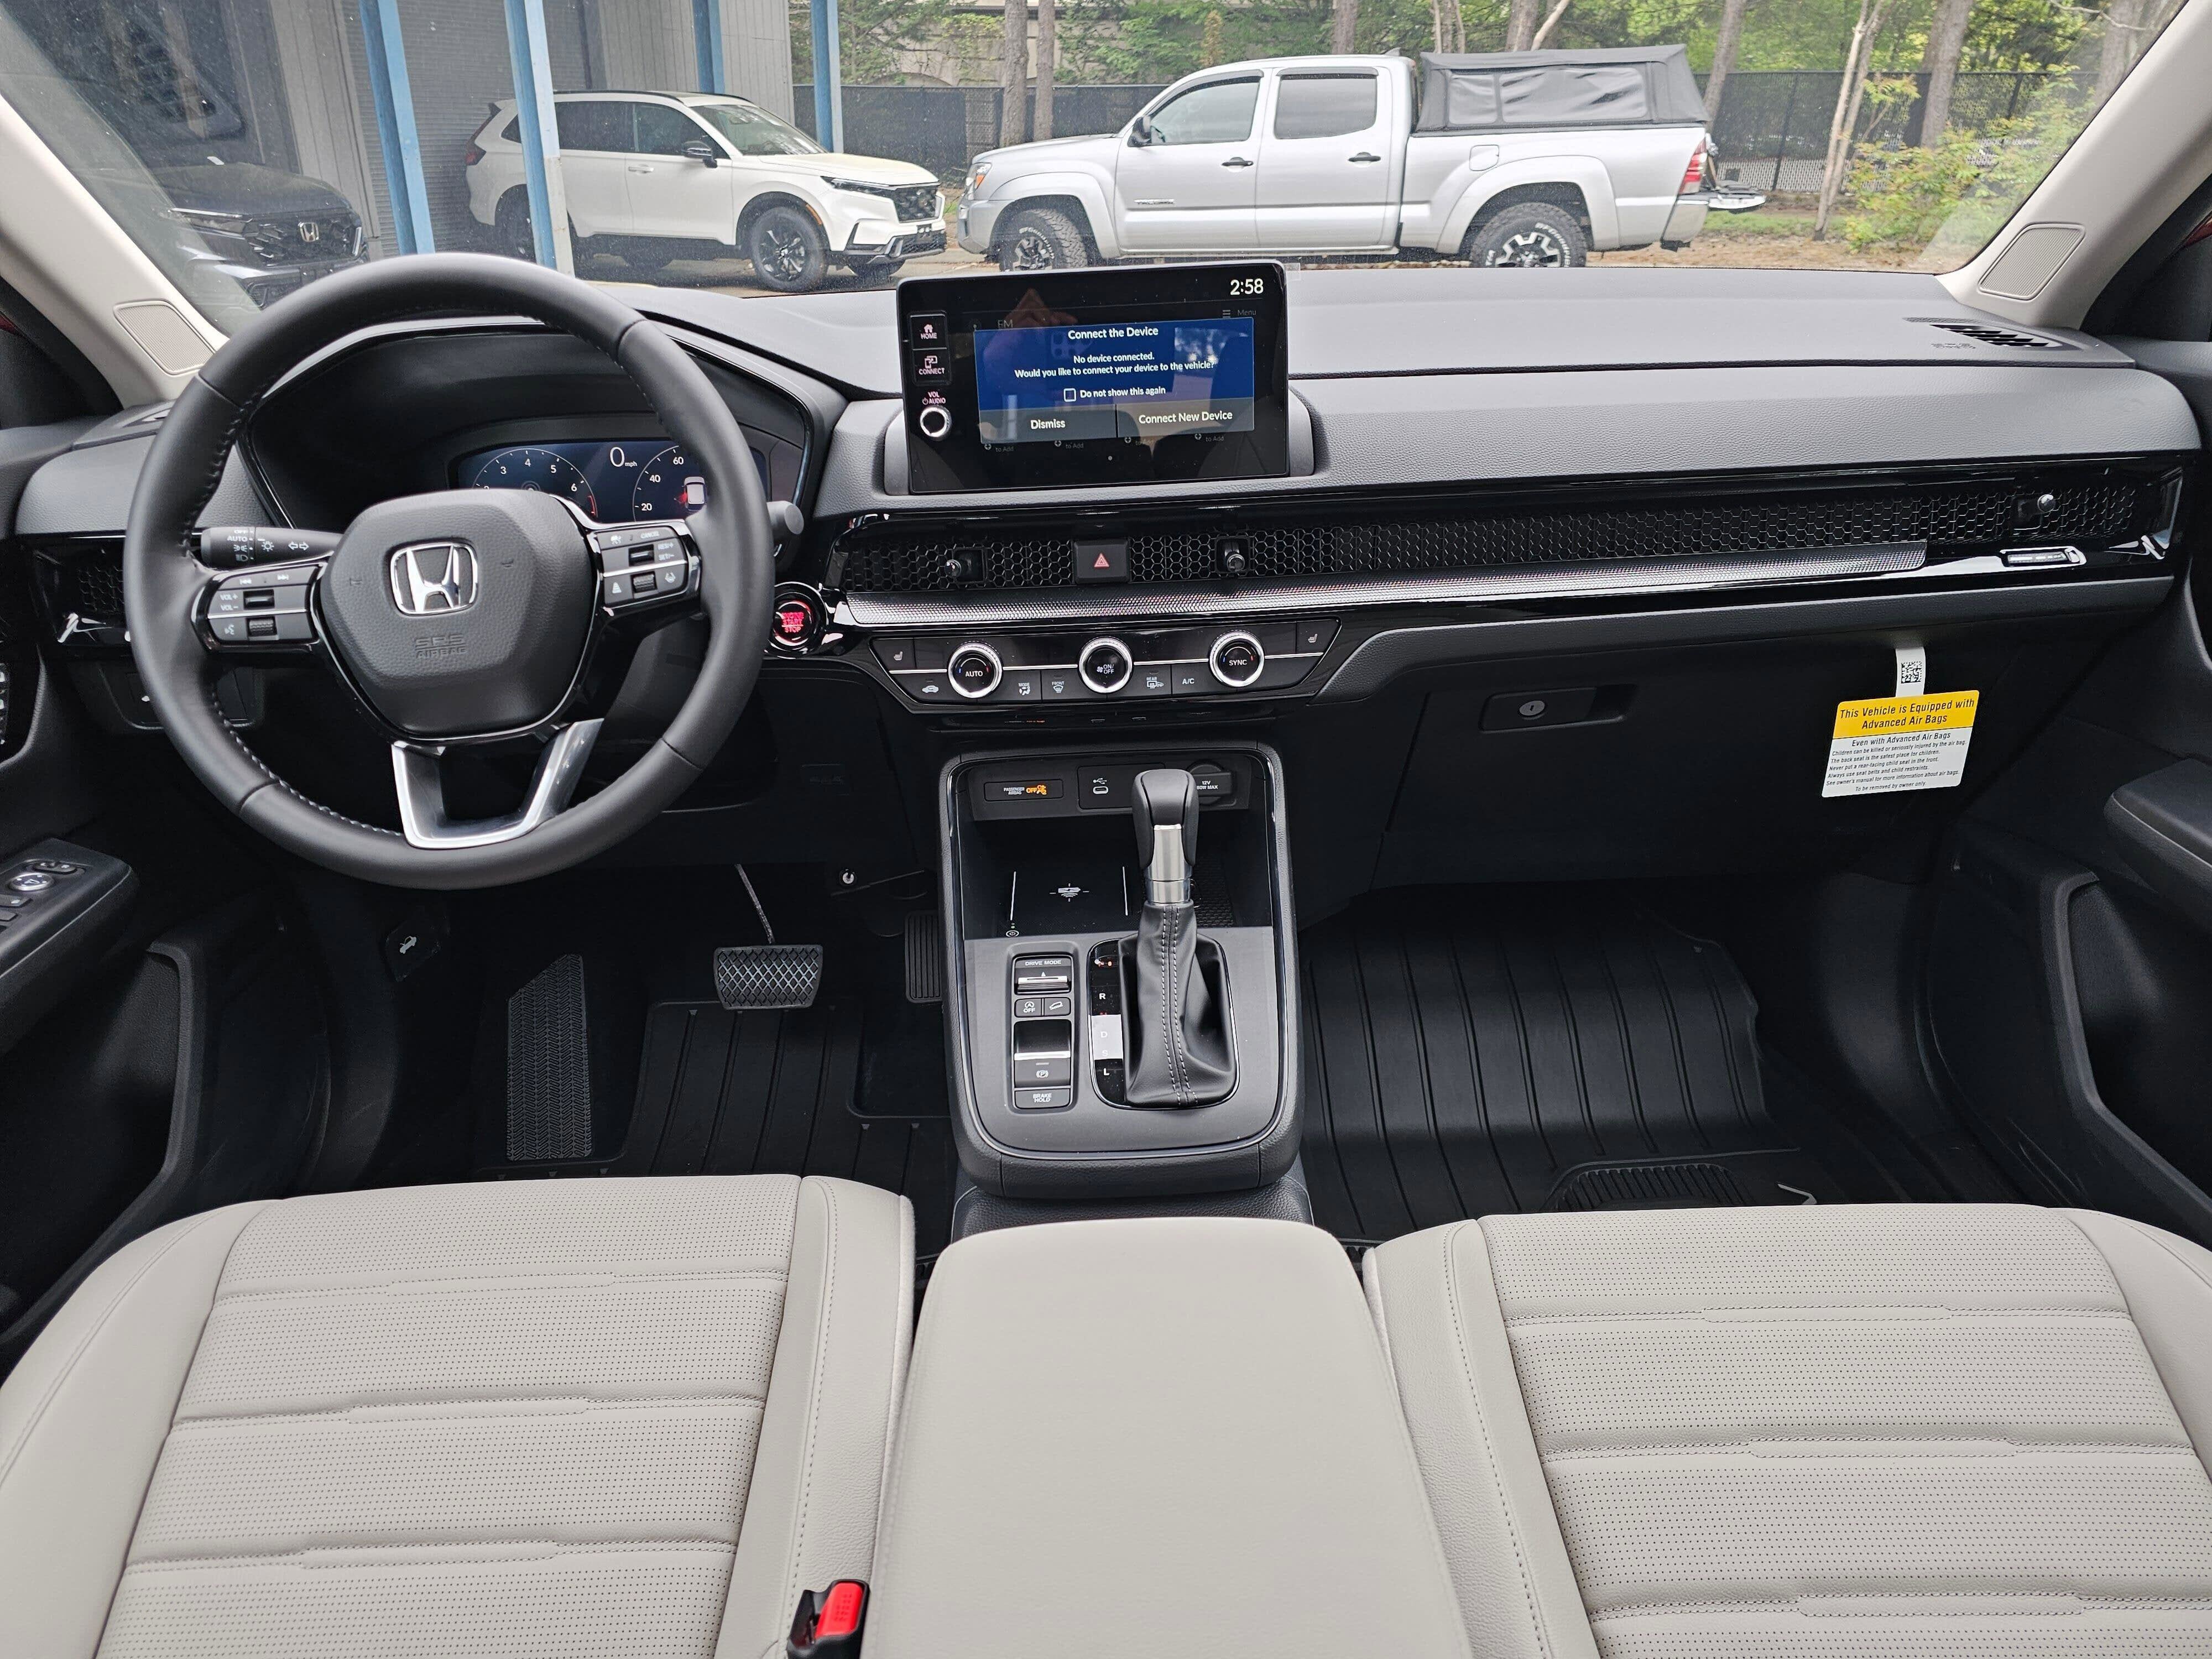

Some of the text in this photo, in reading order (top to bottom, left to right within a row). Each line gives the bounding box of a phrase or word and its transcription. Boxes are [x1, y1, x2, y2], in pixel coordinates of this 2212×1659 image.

[1230, 278, 1264, 295] 2:58
[1068, 326, 1159, 340] Connect the Device
[1073, 352, 1154, 364] No device connected.
[1014, 369, 1040, 378] Would
[1083, 364, 1113, 374] connect
[1115, 364, 1133, 374] your
[1134, 362, 1159, 372] device
[1160, 363, 1168, 371] to
[1170, 361, 1183, 371] the
[1184, 359, 1214, 369] vehicle?
[1080, 386, 1166, 398] Do not show this again
[1139, 410, 1233, 424] Connect New Device
[1030, 419, 1066, 430] Dismiss
[525, 458, 531, 467] 4
[610, 447, 625, 467] 0
[673, 456, 684, 465] 60
[500, 466, 507, 474] 3
[551, 465, 557, 473] 5
[649, 474, 661, 483] 40
[571, 483, 577, 492] 6
[641, 503, 653, 511] 20
[640, 530, 660, 539] CANCEL
[1840, 698, 1974, 718] This Vehicle is Equipped with
[1862, 714, 1947, 729] Advanced Air Bags
[1887, 734, 1920, 743] Advanced
